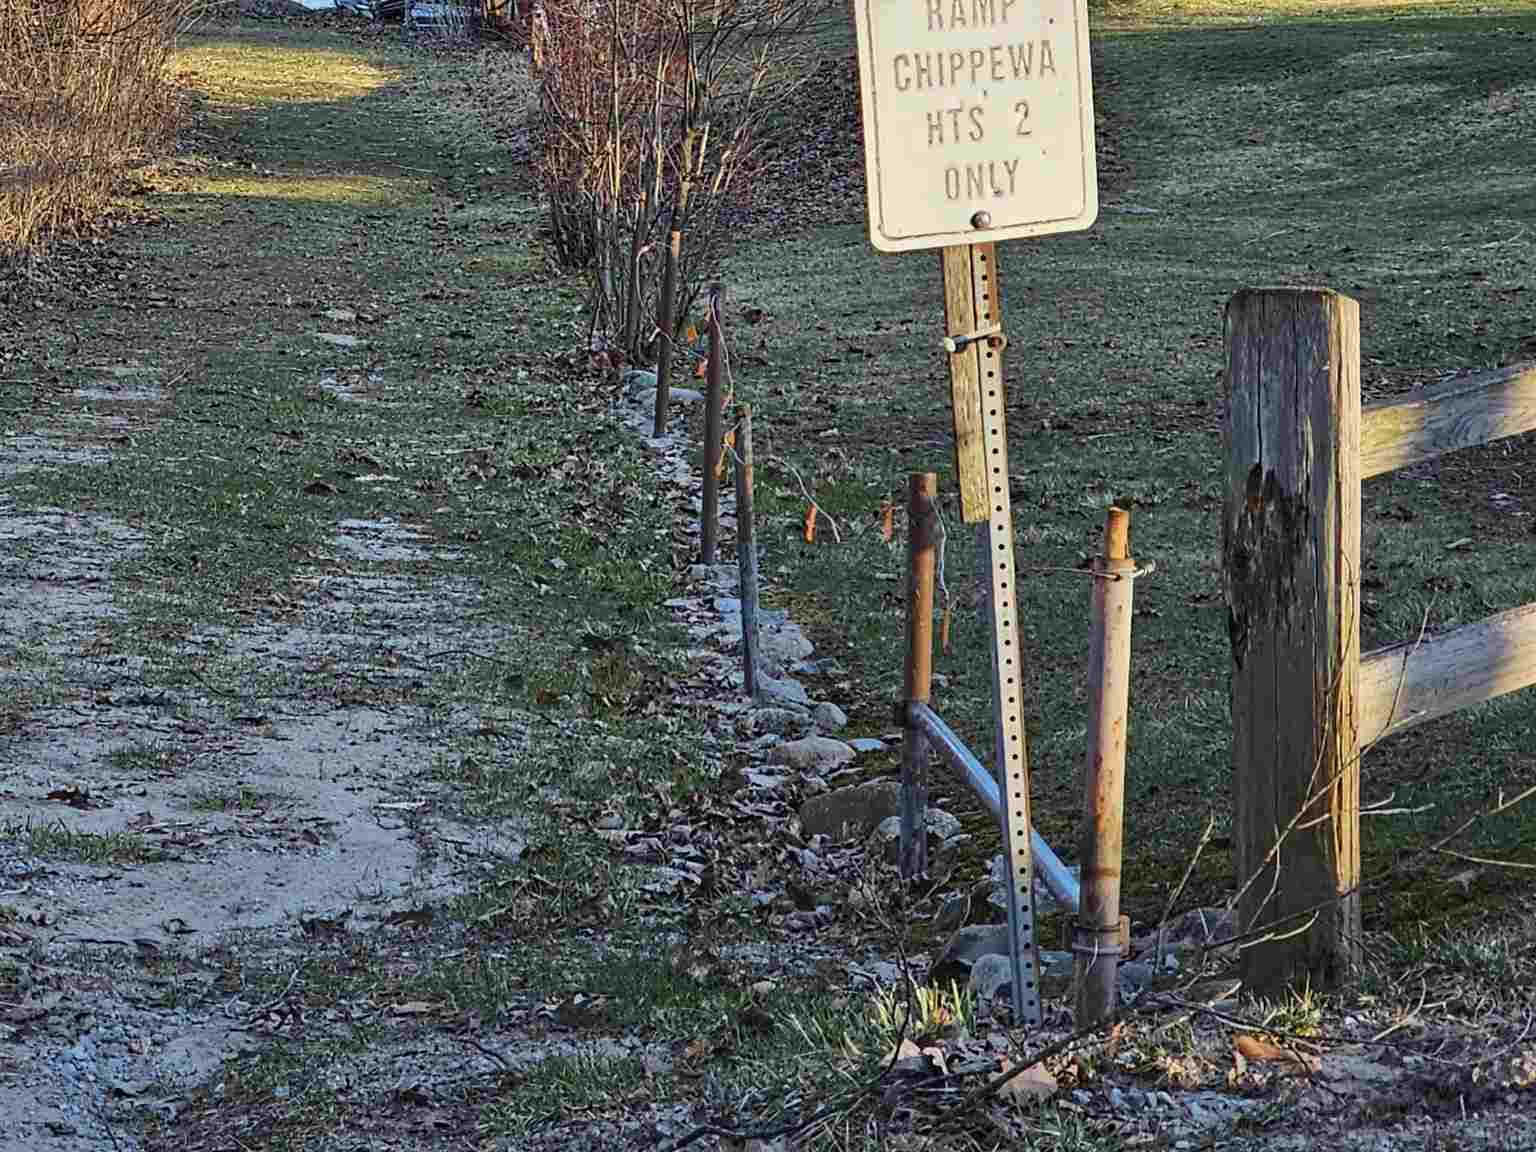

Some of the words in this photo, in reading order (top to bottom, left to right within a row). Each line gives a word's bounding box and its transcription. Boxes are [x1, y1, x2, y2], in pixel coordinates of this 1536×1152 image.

[893, 39, 1056, 91] CHIPPEWA
[927, 105, 985, 145] HTS
[1015, 101, 1033, 136] 2
[945, 159, 1019, 200] ONLY
